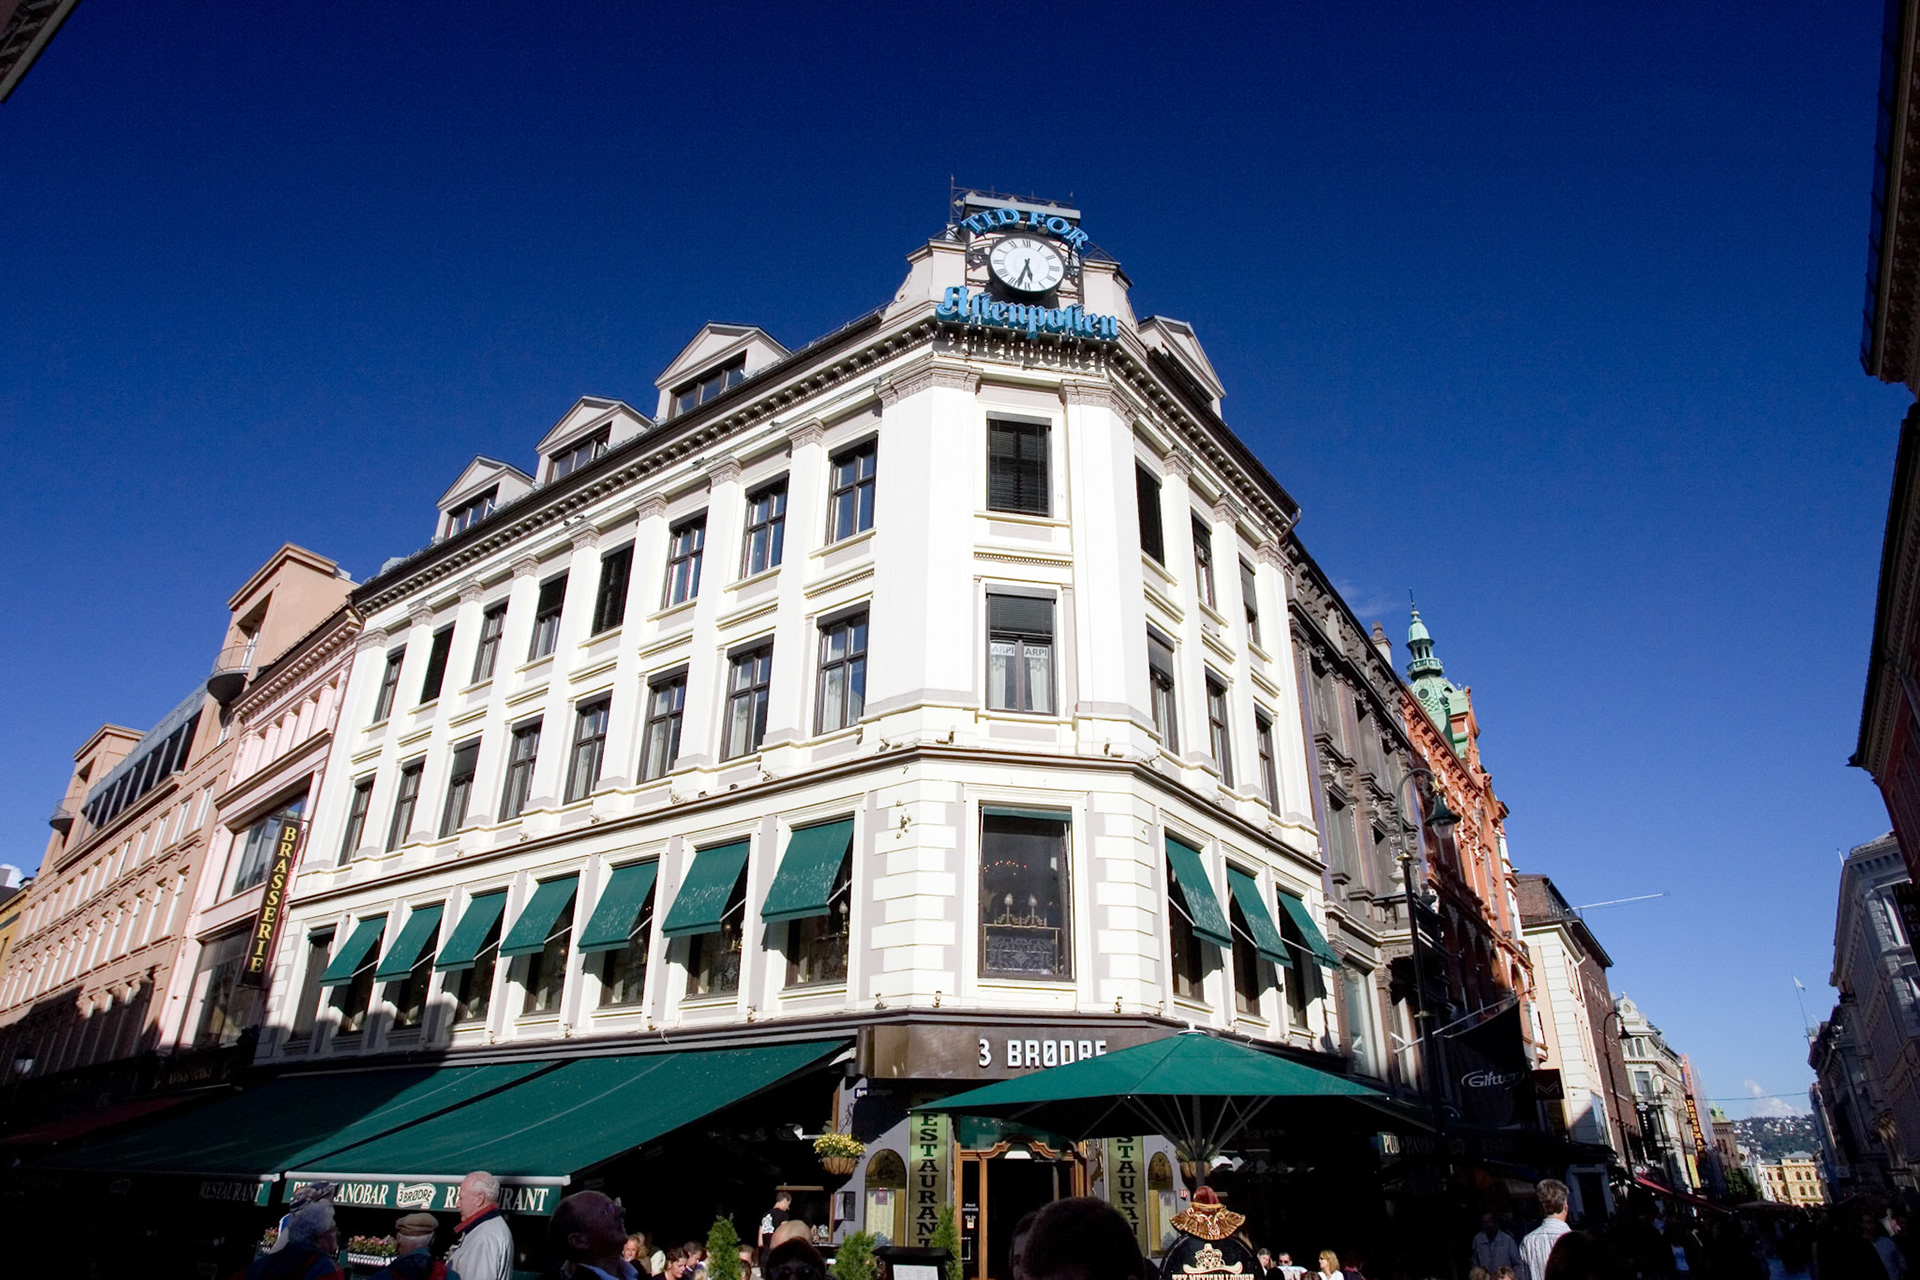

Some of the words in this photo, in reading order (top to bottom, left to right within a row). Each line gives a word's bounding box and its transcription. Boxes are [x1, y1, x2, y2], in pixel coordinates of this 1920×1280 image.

[961, 208, 1020, 235] TID
[1028, 210, 1090, 249] FOR
[935, 285, 1119, 340] Aftenposten
[249, 826, 297, 973] BRASSERIE
[979, 1038, 992, 1068] 3
[1007, 1039, 1107, 1068] BRØDRE
[1468, 1069, 1520, 1088] Glitter
[1382, 1134, 1400, 1154] PUB
[200, 1181, 264, 1202] RESTAURANT
